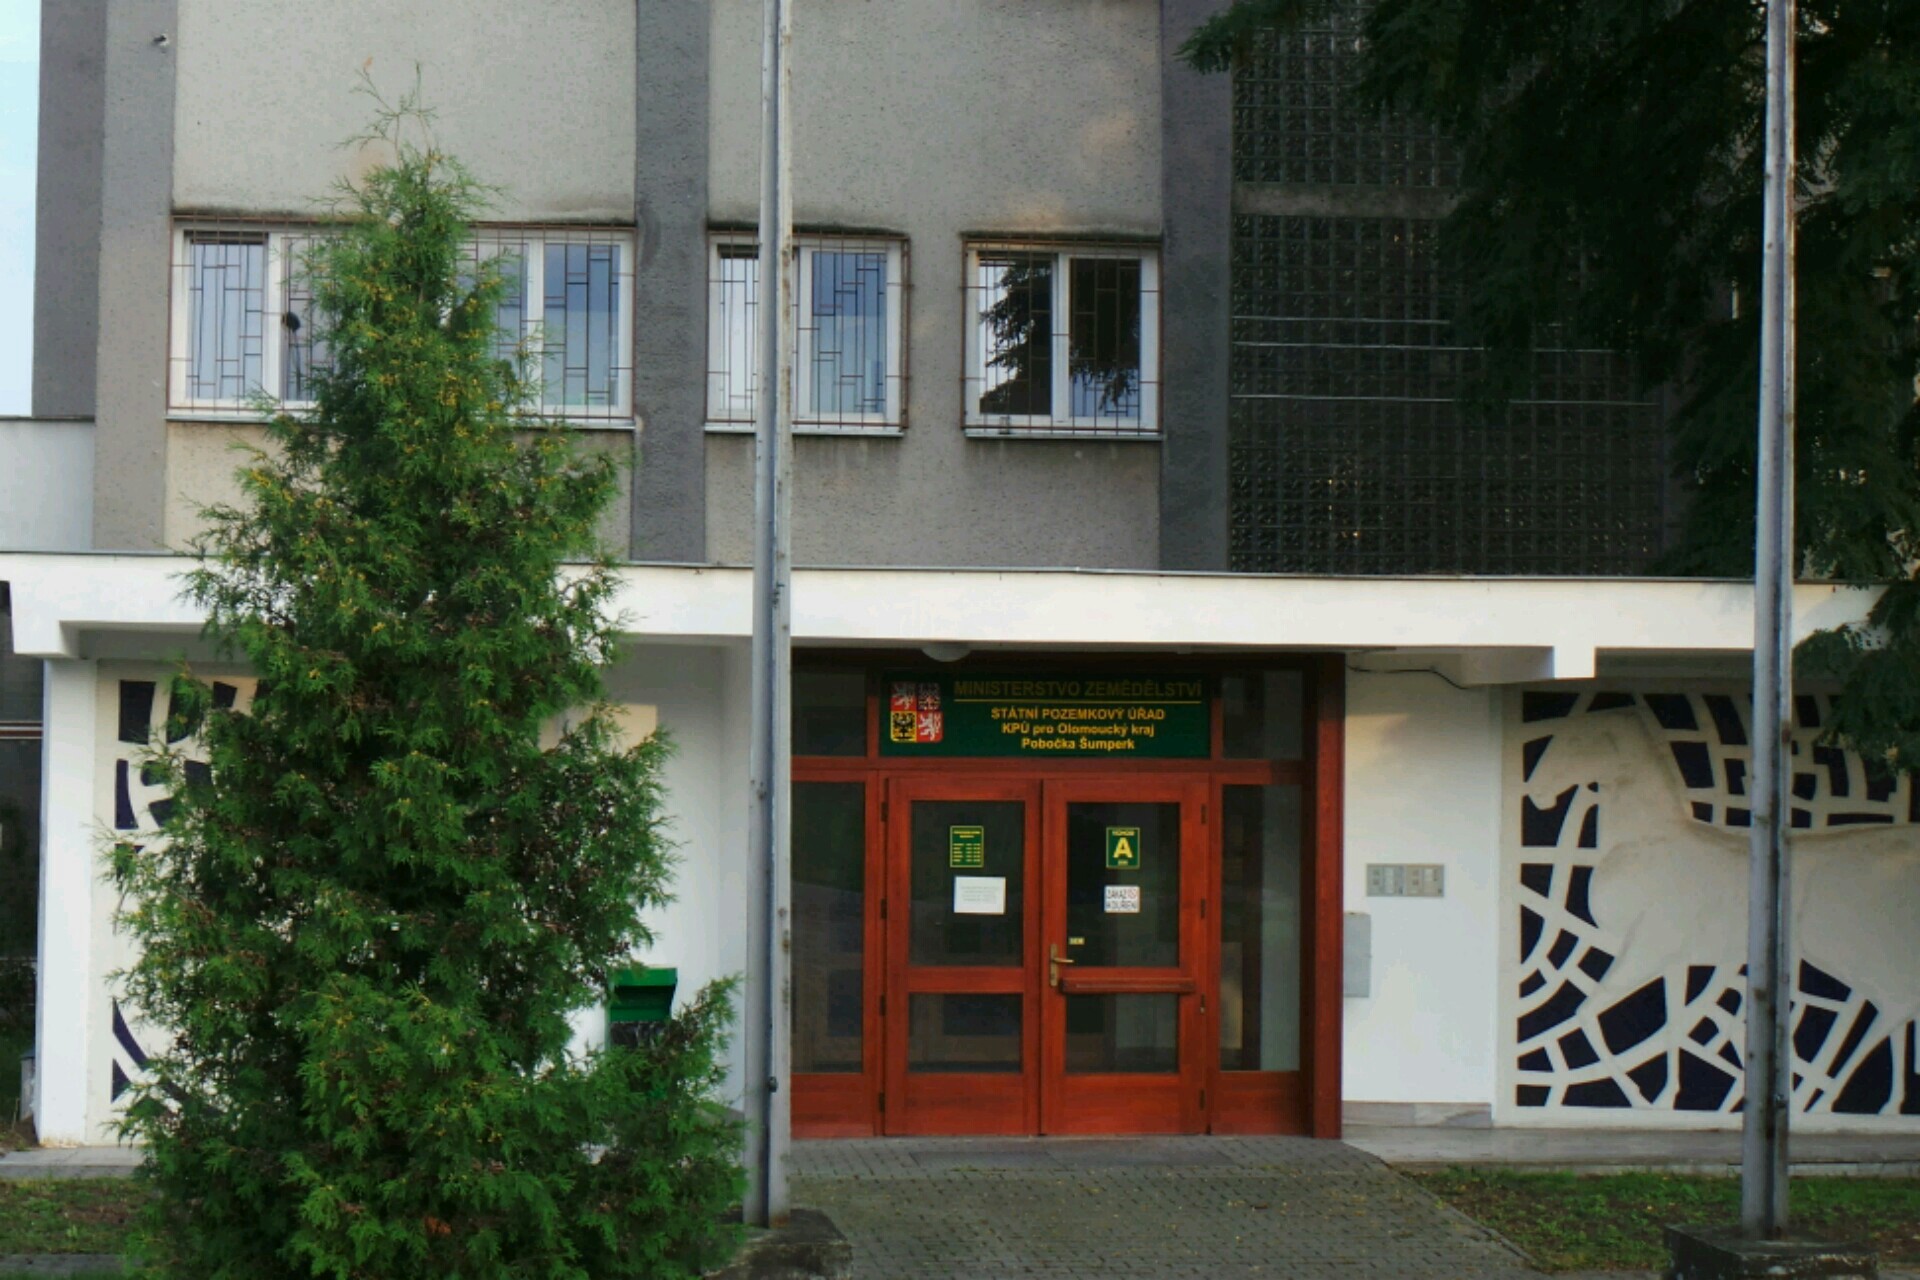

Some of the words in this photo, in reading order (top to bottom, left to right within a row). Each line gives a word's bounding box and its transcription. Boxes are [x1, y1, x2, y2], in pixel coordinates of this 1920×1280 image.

[954, 681, 1080, 697] MINISTERSTVO
[1084, 679, 1202, 697] ZEMĚDĚLSTVÍ
[991, 706, 1038, 719] STÁTNÍ
[1042, 707, 1124, 720] POZEMKOVÝ
[1127, 706, 1165, 720] ÚŘAD
[1002, 721, 1030, 734] KPÚ
[1033, 725, 1054, 736] pro
[1058, 722, 1128, 737] Olomoucký
[1131, 723, 1155, 737] kraj
[1022, 738, 1076, 749] Pobočka
[1079, 736, 1135, 751] Šumperk
[1113, 837, 1133, 858] A
